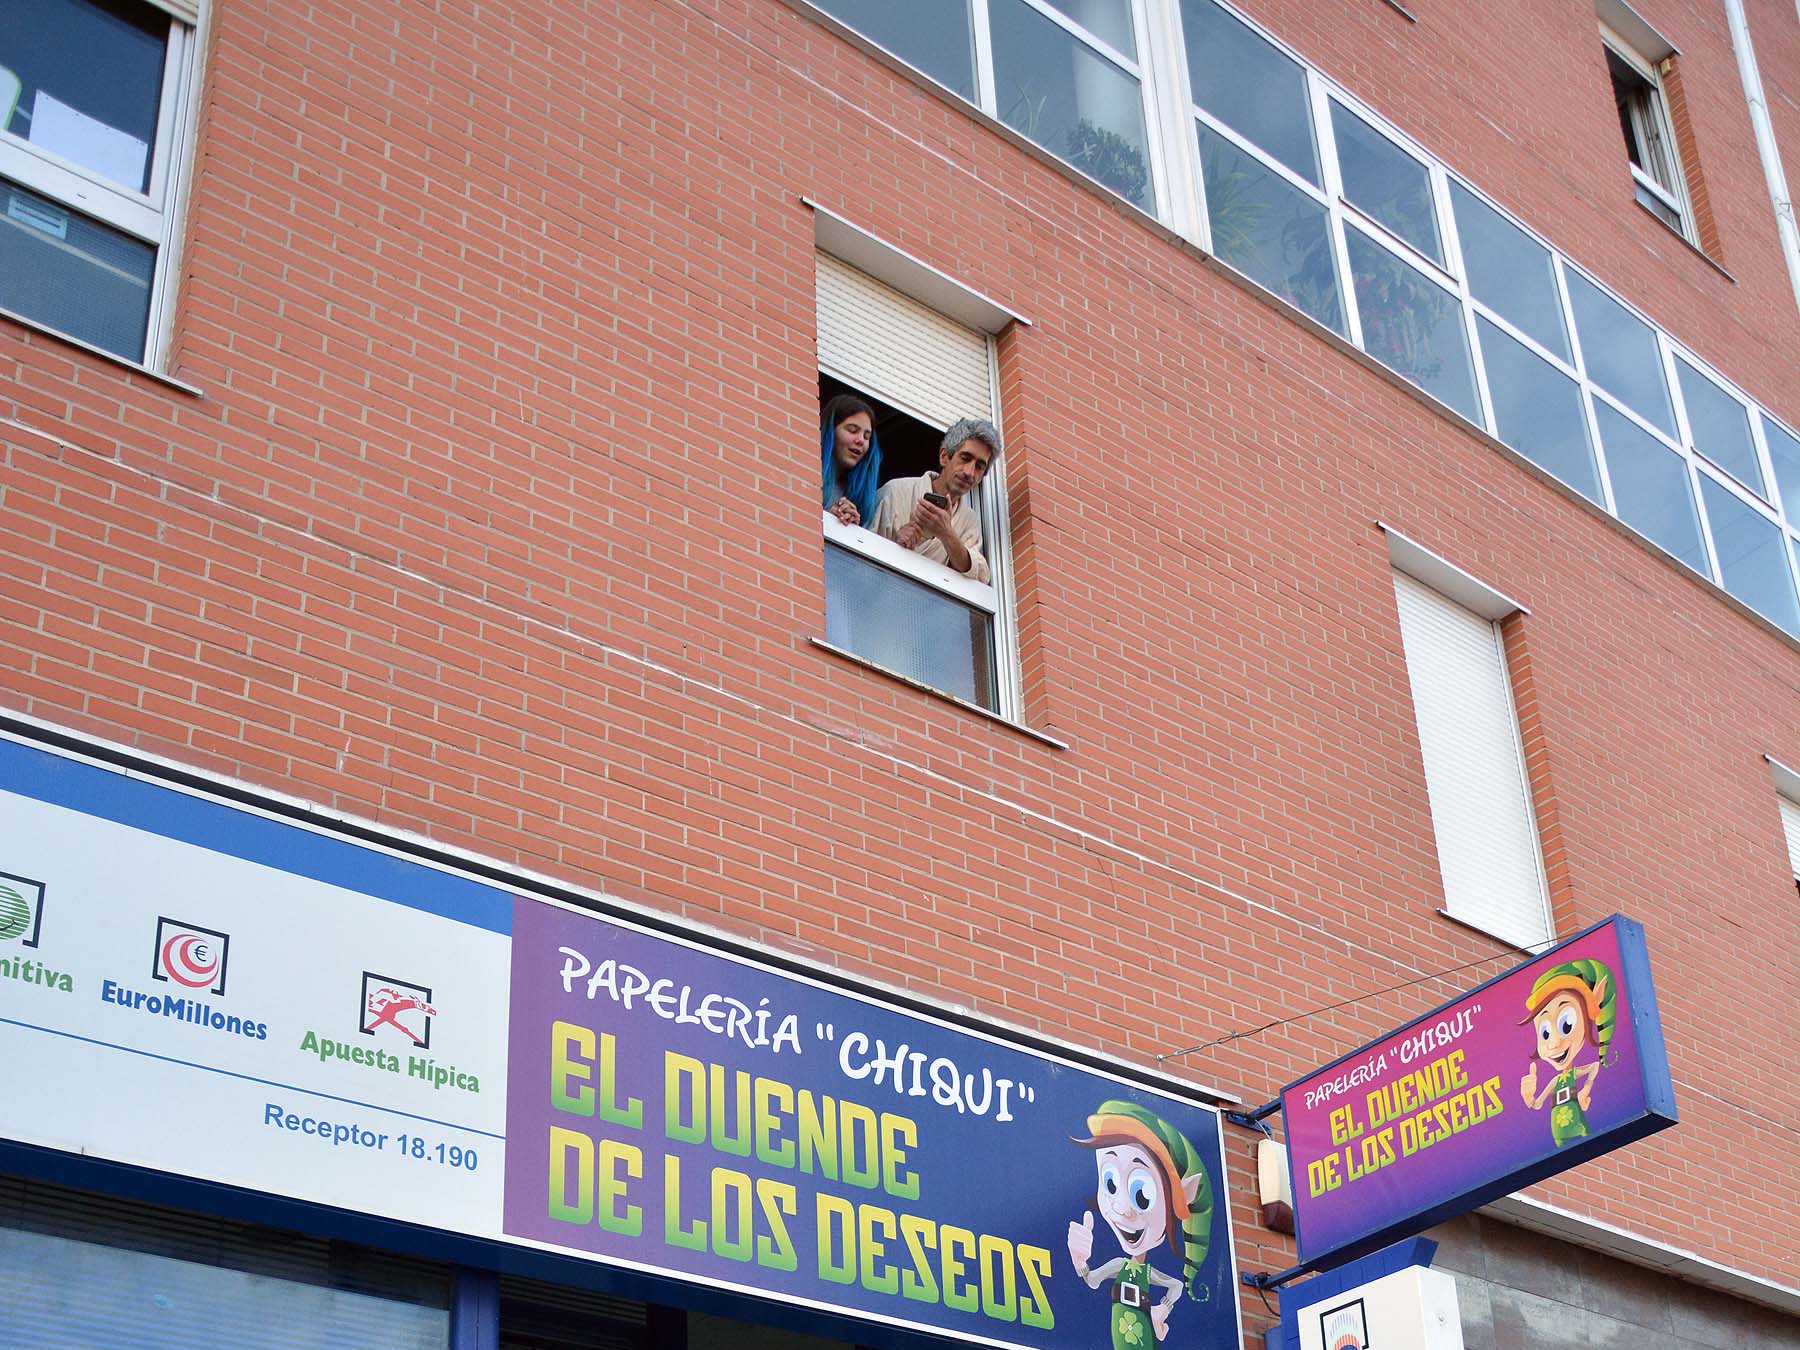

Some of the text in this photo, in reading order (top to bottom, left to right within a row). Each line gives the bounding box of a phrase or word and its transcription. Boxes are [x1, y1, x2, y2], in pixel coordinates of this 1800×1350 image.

[101, 979, 268, 1041] EuroMillones
[559, 945, 802, 1056] PAPELERÍA
[300, 1031, 480, 1093] Apuesta Hípica
[551, 1021, 920, 1201] EL DUENDE
[1304, 1054, 1389, 1110] PAPELERÍA
[1329, 1048, 1469, 1146] EL DUENDE
[264, 1103, 478, 1171] Receptor 18.190
[1307, 1075, 1504, 1198] DE LOS DESEOS
[549, 1126, 1056, 1331] DE LOS DESEOS
